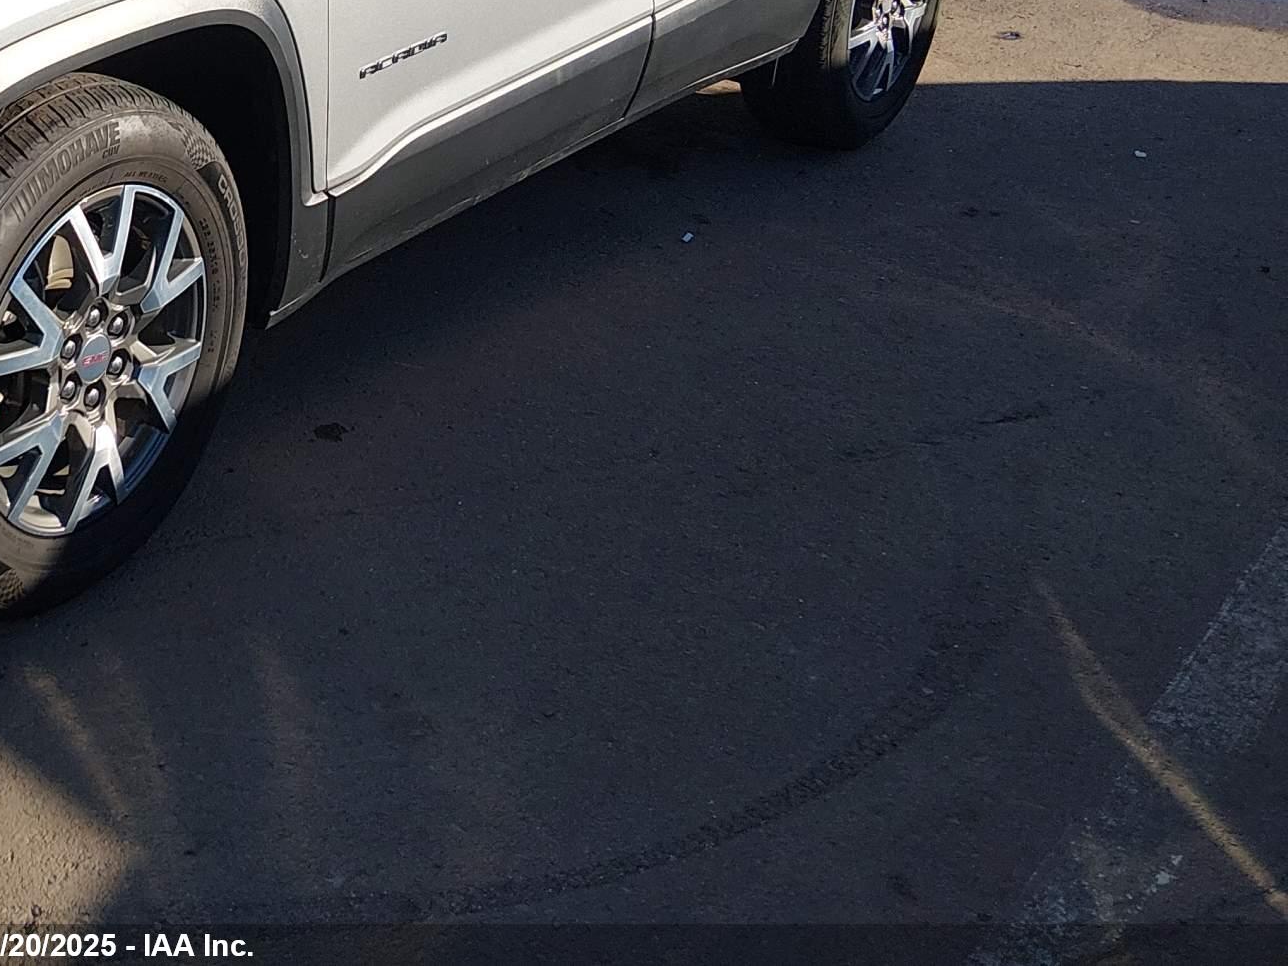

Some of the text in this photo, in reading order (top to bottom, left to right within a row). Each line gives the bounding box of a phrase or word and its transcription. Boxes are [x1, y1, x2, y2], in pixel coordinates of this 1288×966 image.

[358, 32, 448, 80] ACADIA
[32, 120, 122, 194] MOHAVE
[102, 144, 122, 160] CUV
